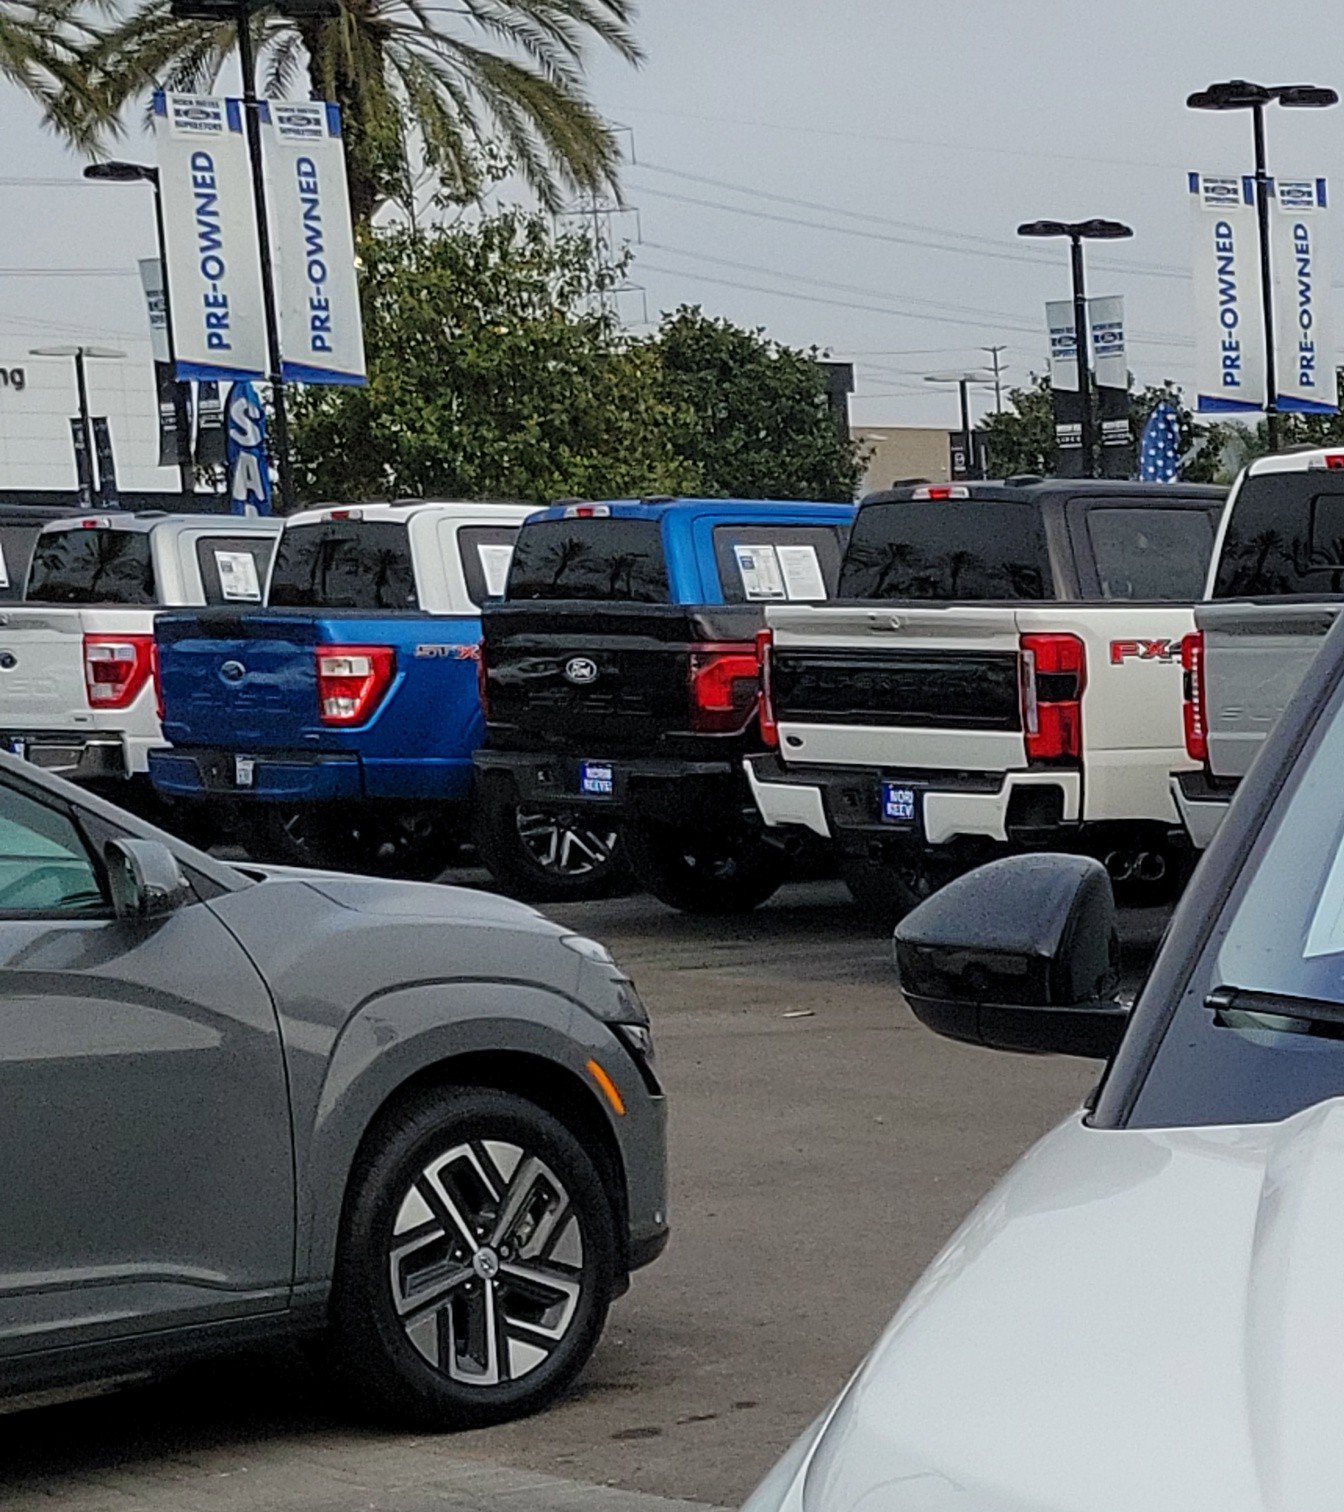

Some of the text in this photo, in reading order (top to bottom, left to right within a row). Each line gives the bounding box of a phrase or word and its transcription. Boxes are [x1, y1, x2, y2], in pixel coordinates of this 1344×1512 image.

[191, 151, 231, 350] PRE-OWNED
[296, 157, 333, 353] PRE-OWNED
[1215, 221, 1241, 387] PRE-OWNED
[1293, 223, 1315, 387] PRE-OWNED
[0, 368, 25, 390] ng
[229, 397, 267, 517] SA
